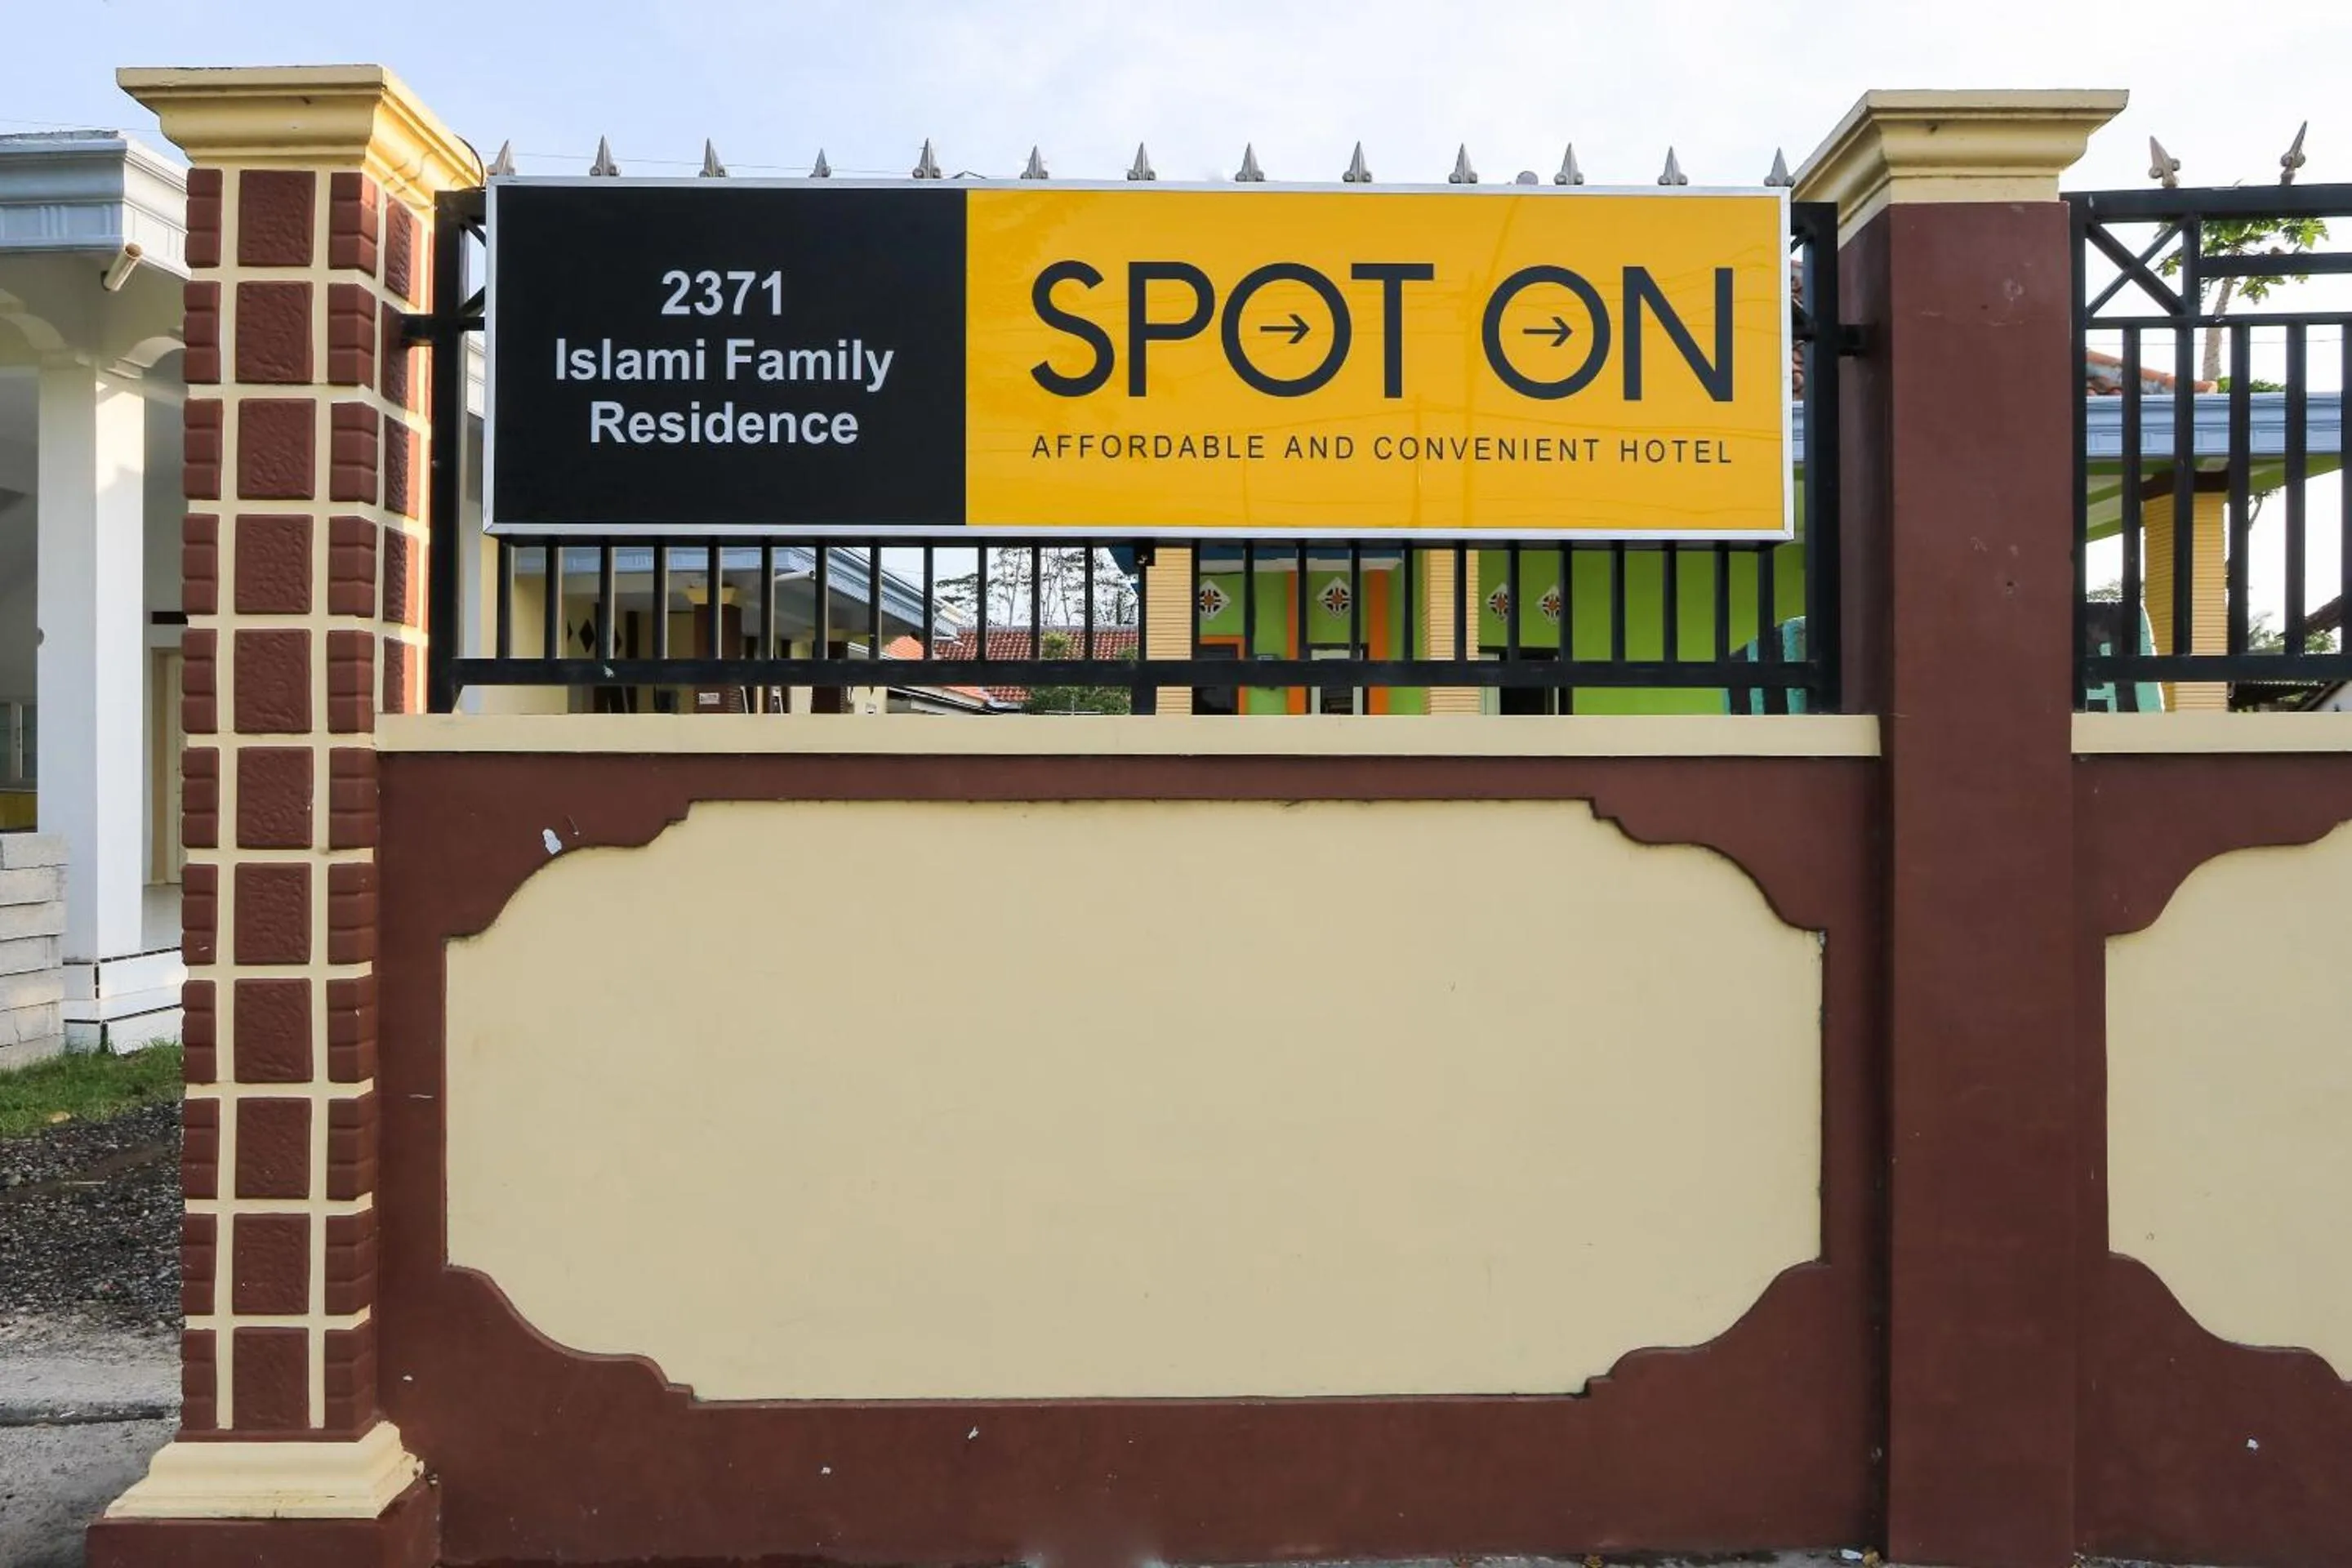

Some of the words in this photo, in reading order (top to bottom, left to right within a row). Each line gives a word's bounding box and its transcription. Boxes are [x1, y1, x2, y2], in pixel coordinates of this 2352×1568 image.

[662, 271, 784, 315] 2371
[1031, 261, 1434, 399] SPOT
[1481, 265, 1733, 402] ON
[557, 339, 705, 381] Islami
[727, 339, 893, 392] Family
[591, 401, 858, 443] Residence
[1031, 434, 1264, 459] AFFORDABLE
[1284, 435, 1354, 460] AND
[1374, 436, 1600, 461] CONVENIENT
[1620, 440, 1732, 464] HOTEL
